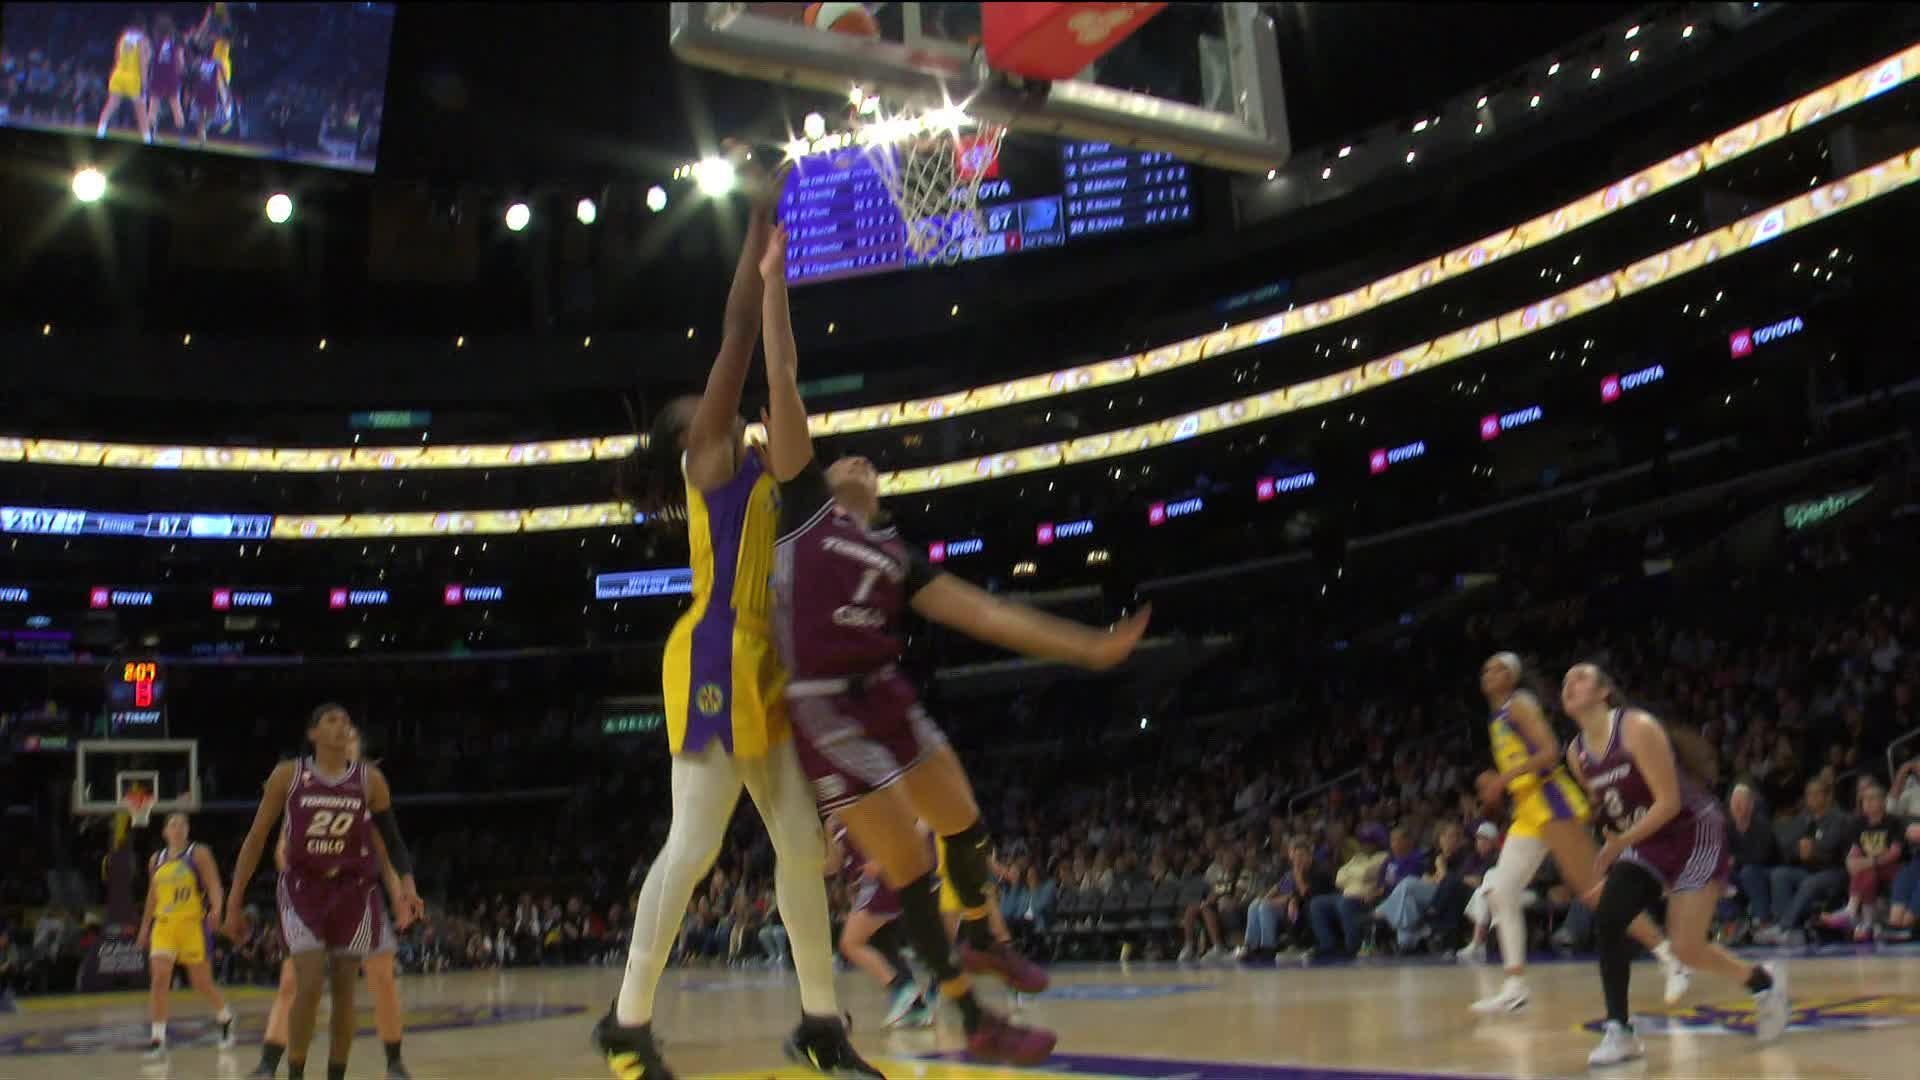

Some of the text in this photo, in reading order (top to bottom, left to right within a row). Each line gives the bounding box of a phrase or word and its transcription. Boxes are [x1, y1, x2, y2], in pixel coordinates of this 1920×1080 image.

[1752, 316, 1803, 346] TOYOTA
[1619, 364, 1664, 391] TOYOTA
[1499, 405, 1543, 431] TOYOTA
[1386, 440, 1425, 465] TOYOTA
[1275, 471, 1316, 493] TOYOTA
[1165, 498, 1204, 518] TOYOTA
[1055, 519, 1094, 539] TOYOTA
[946, 539, 984, 557] TOYOTA
[112, 590, 153, 606] TOYOTA
[232, 592, 272, 606] TOYOTA
[349, 590, 389, 605] TOYOTA
[464, 586, 502, 601] TOYOTA
[300, 795, 361, 811] TORONTO
[305, 810, 354, 838] 20
[172, 886, 193, 905] 10
